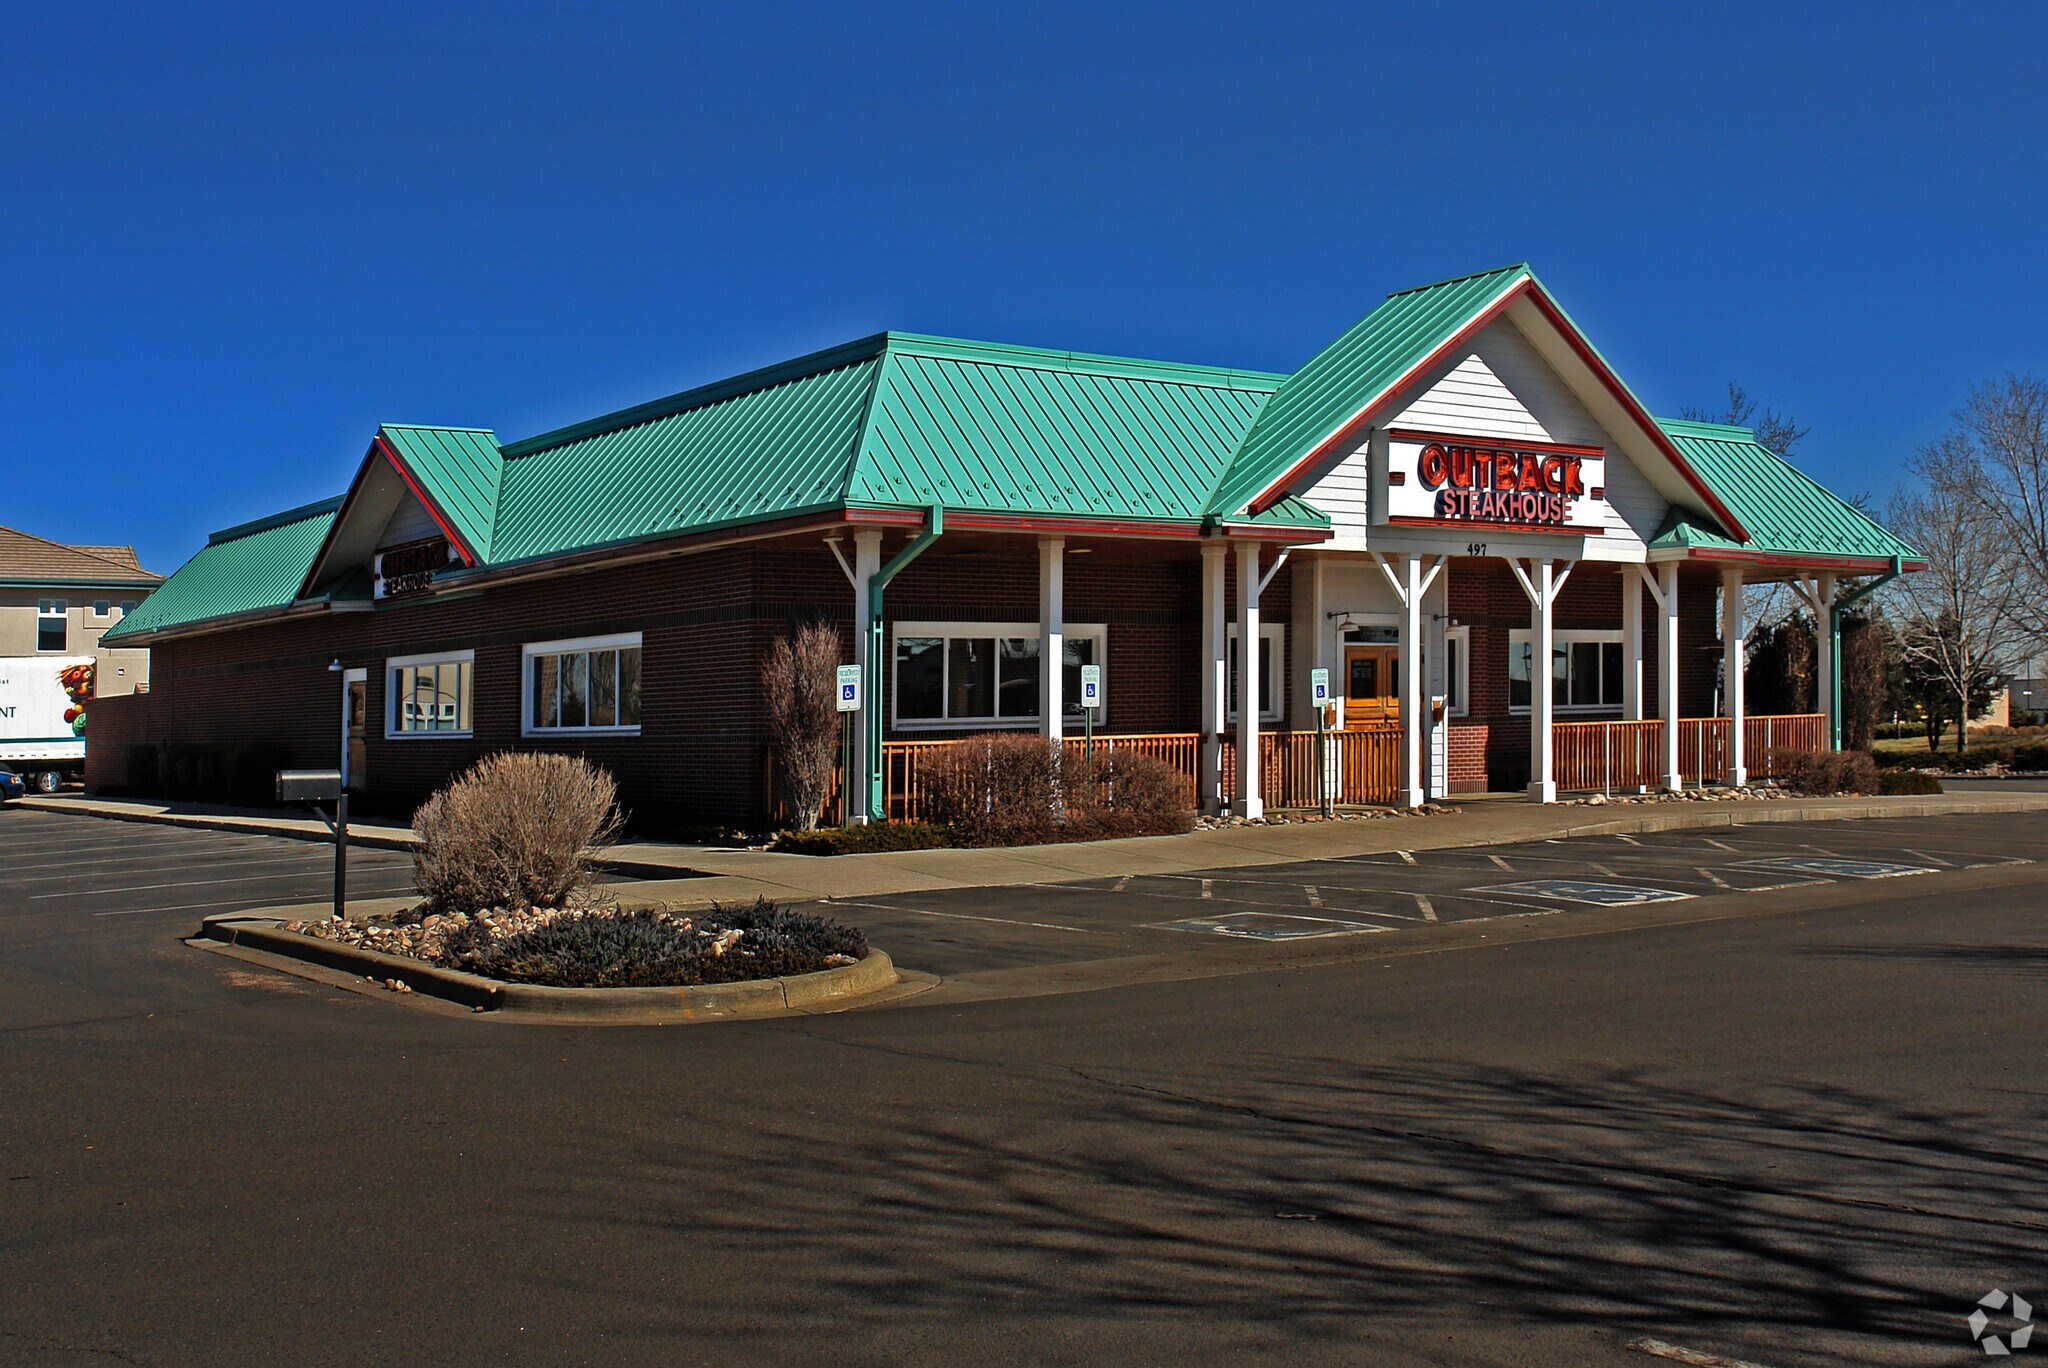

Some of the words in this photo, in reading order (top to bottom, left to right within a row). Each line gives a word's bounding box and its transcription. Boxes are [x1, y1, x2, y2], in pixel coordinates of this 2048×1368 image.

[1418, 443, 1584, 495] OUTBACK
[1443, 488, 1573, 521] STEAKHOUSE
[1467, 542, 1487, 556] 497
